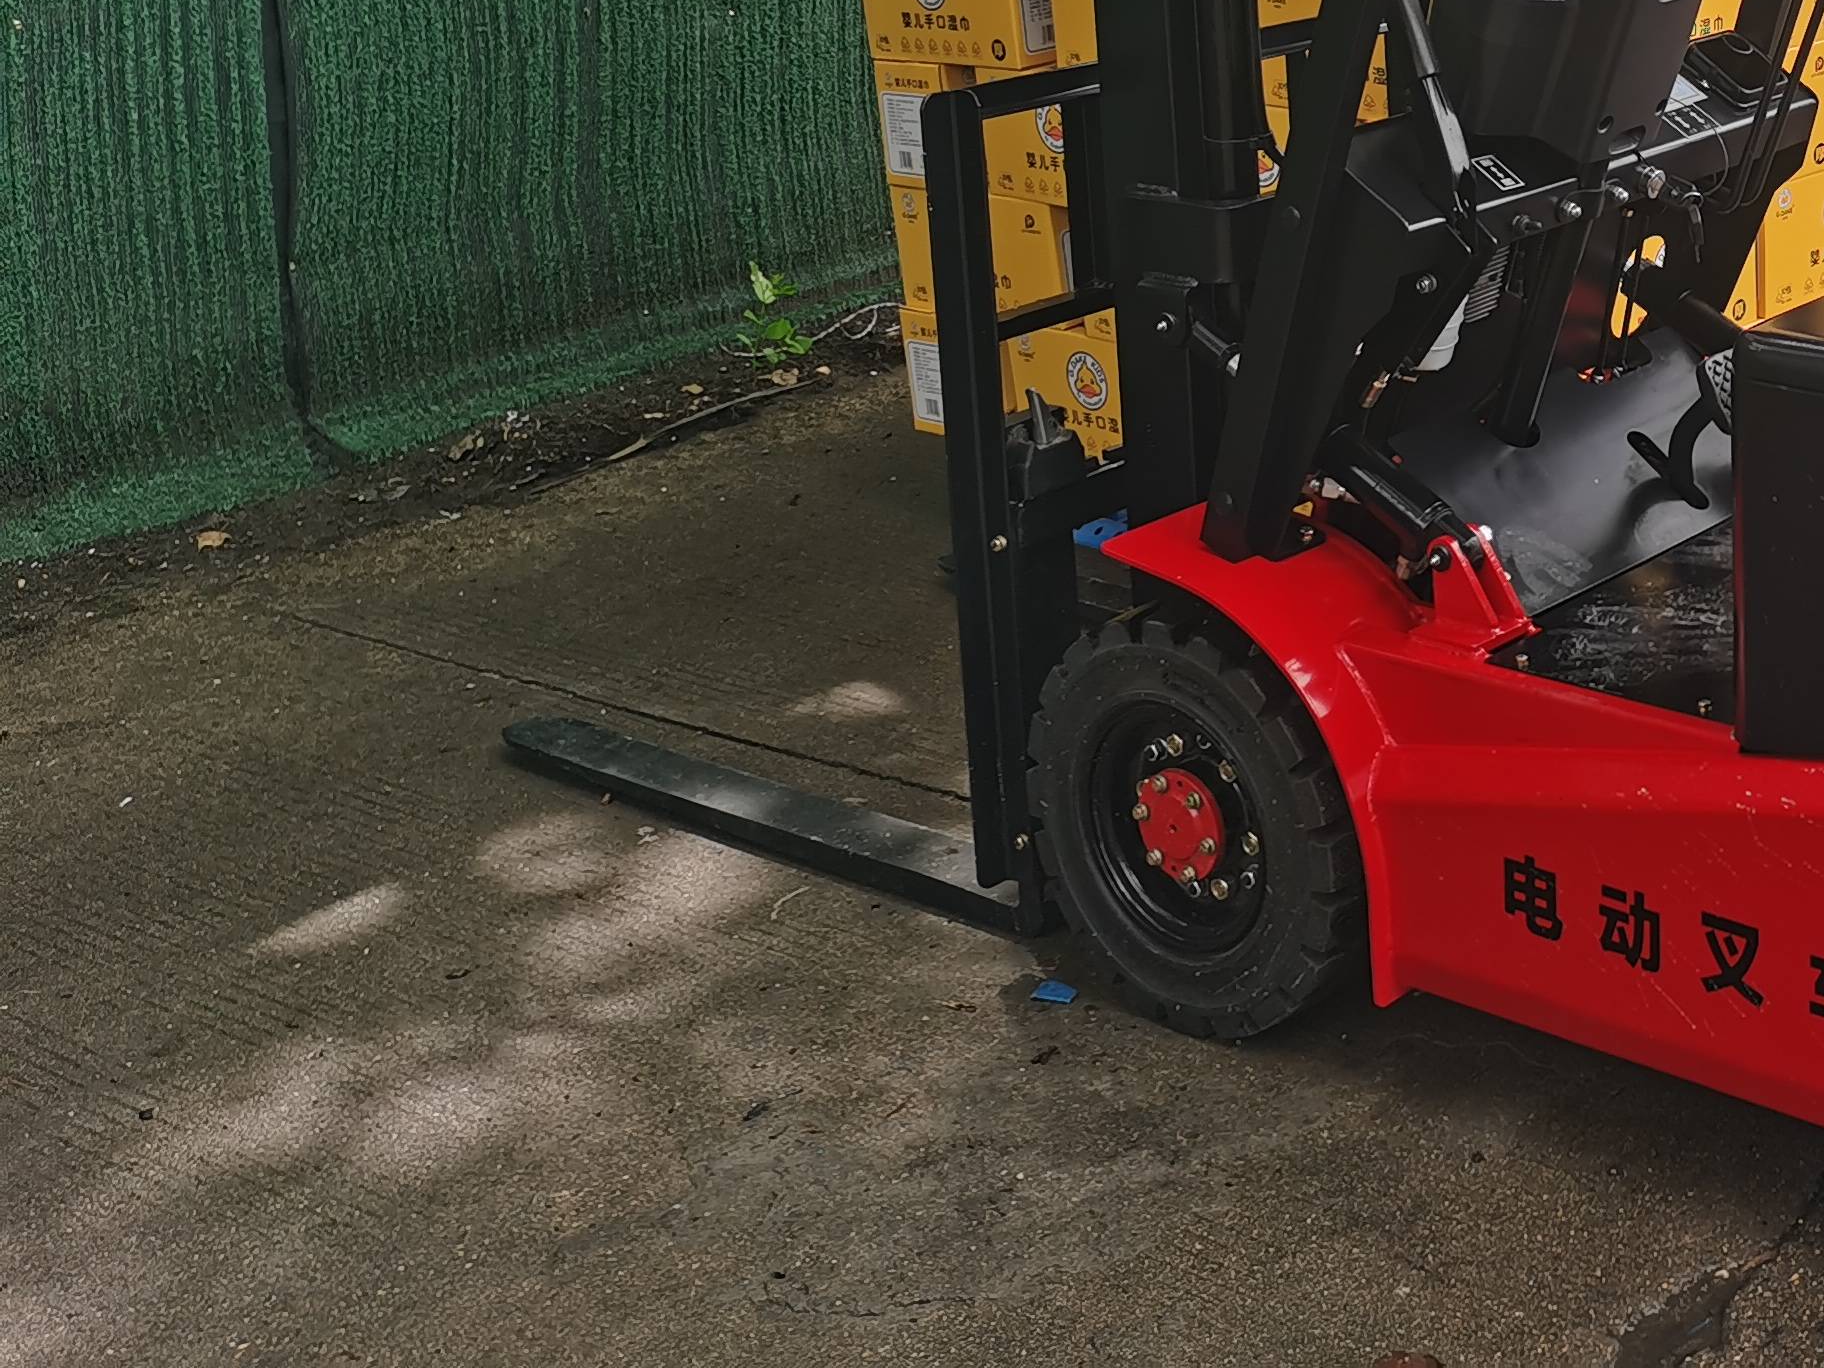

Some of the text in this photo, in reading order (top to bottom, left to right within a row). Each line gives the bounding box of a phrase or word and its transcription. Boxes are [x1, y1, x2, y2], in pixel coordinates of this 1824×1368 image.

[901, 11, 970, 31] 婴儿手口湿巾
